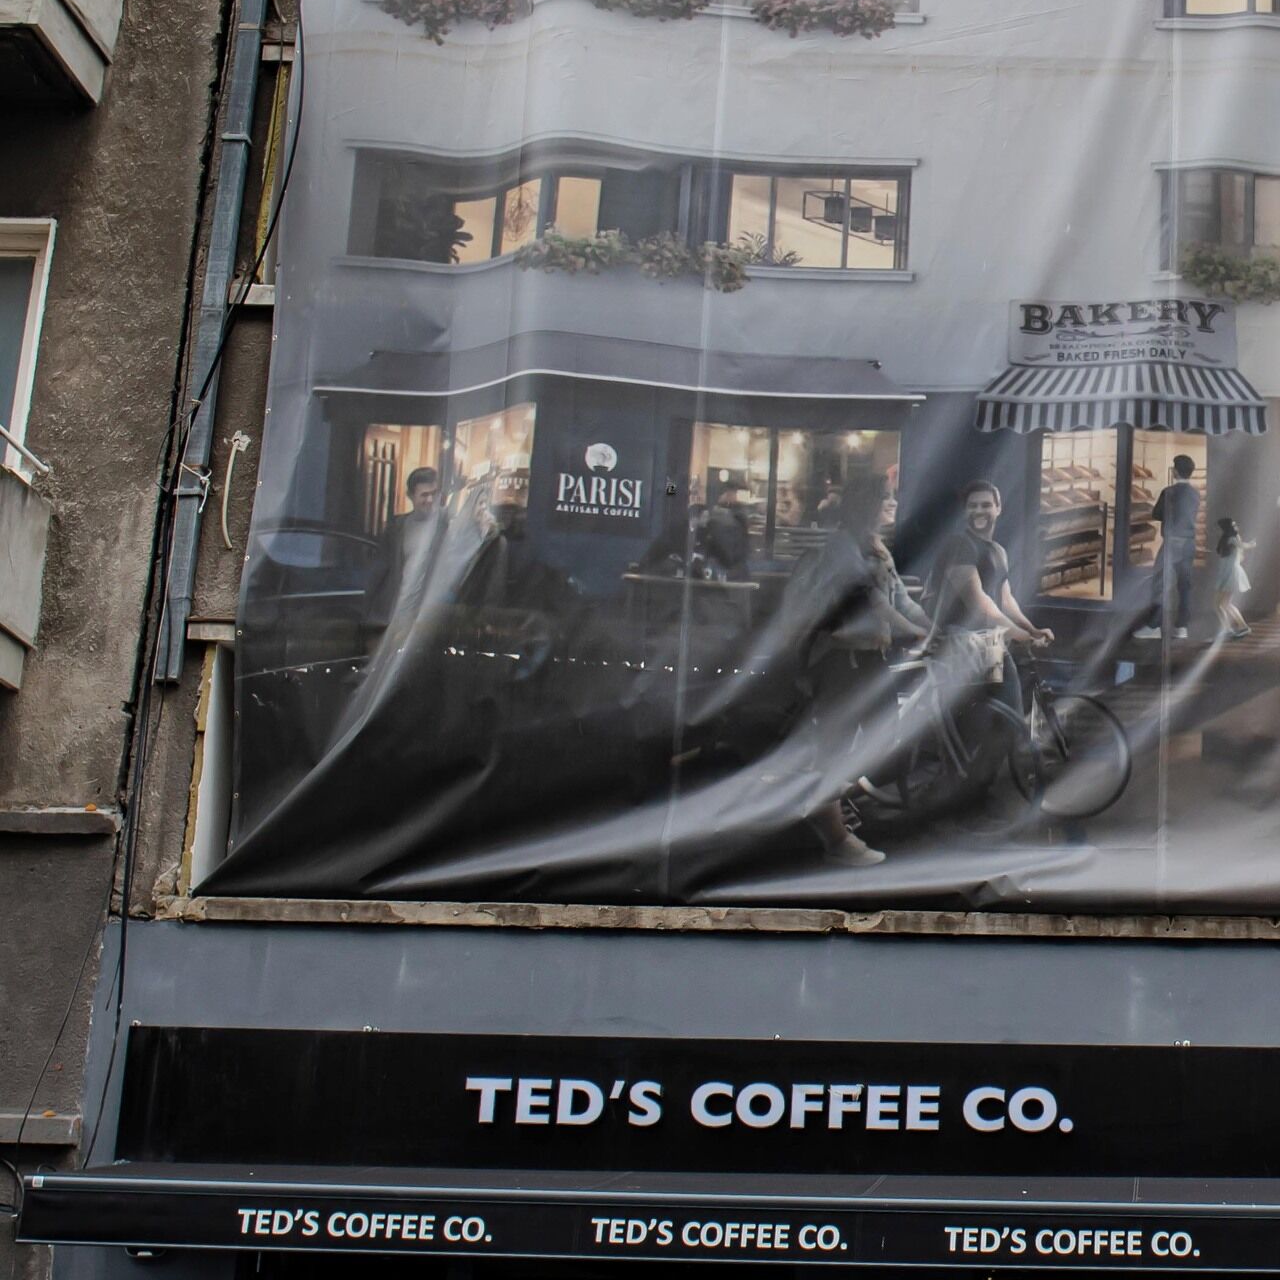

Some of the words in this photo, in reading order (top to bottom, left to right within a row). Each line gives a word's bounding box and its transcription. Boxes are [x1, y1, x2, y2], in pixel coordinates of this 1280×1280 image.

[1020, 299, 1224, 335] BAKERY
[1057, 350, 1099, 362] BAKED
[1104, 349, 1146, 360] FRESH
[1150, 347, 1187, 360] DAILY
[556, 472, 643, 509] PARISI
[556, 503, 599, 515] ARTISAN
[603, 506, 641, 518] COFFEE
[465, 1077, 662, 1126] TED'S
[691, 1082, 940, 1130] COFFEE
[963, 1087, 1074, 1133] CO.
[237, 1209, 320, 1236] TED'S
[327, 1211, 435, 1240] COFFEE
[444, 1215, 493, 1243] CO.
[591, 1217, 673, 1245] TED'S
[682, 1221, 790, 1249] COFFEE
[798, 1225, 848, 1251] CO.
[944, 1226, 1027, 1253] TED'S
[1035, 1230, 1143, 1256] COFFEE
[1151, 1232, 1200, 1257] CO.
